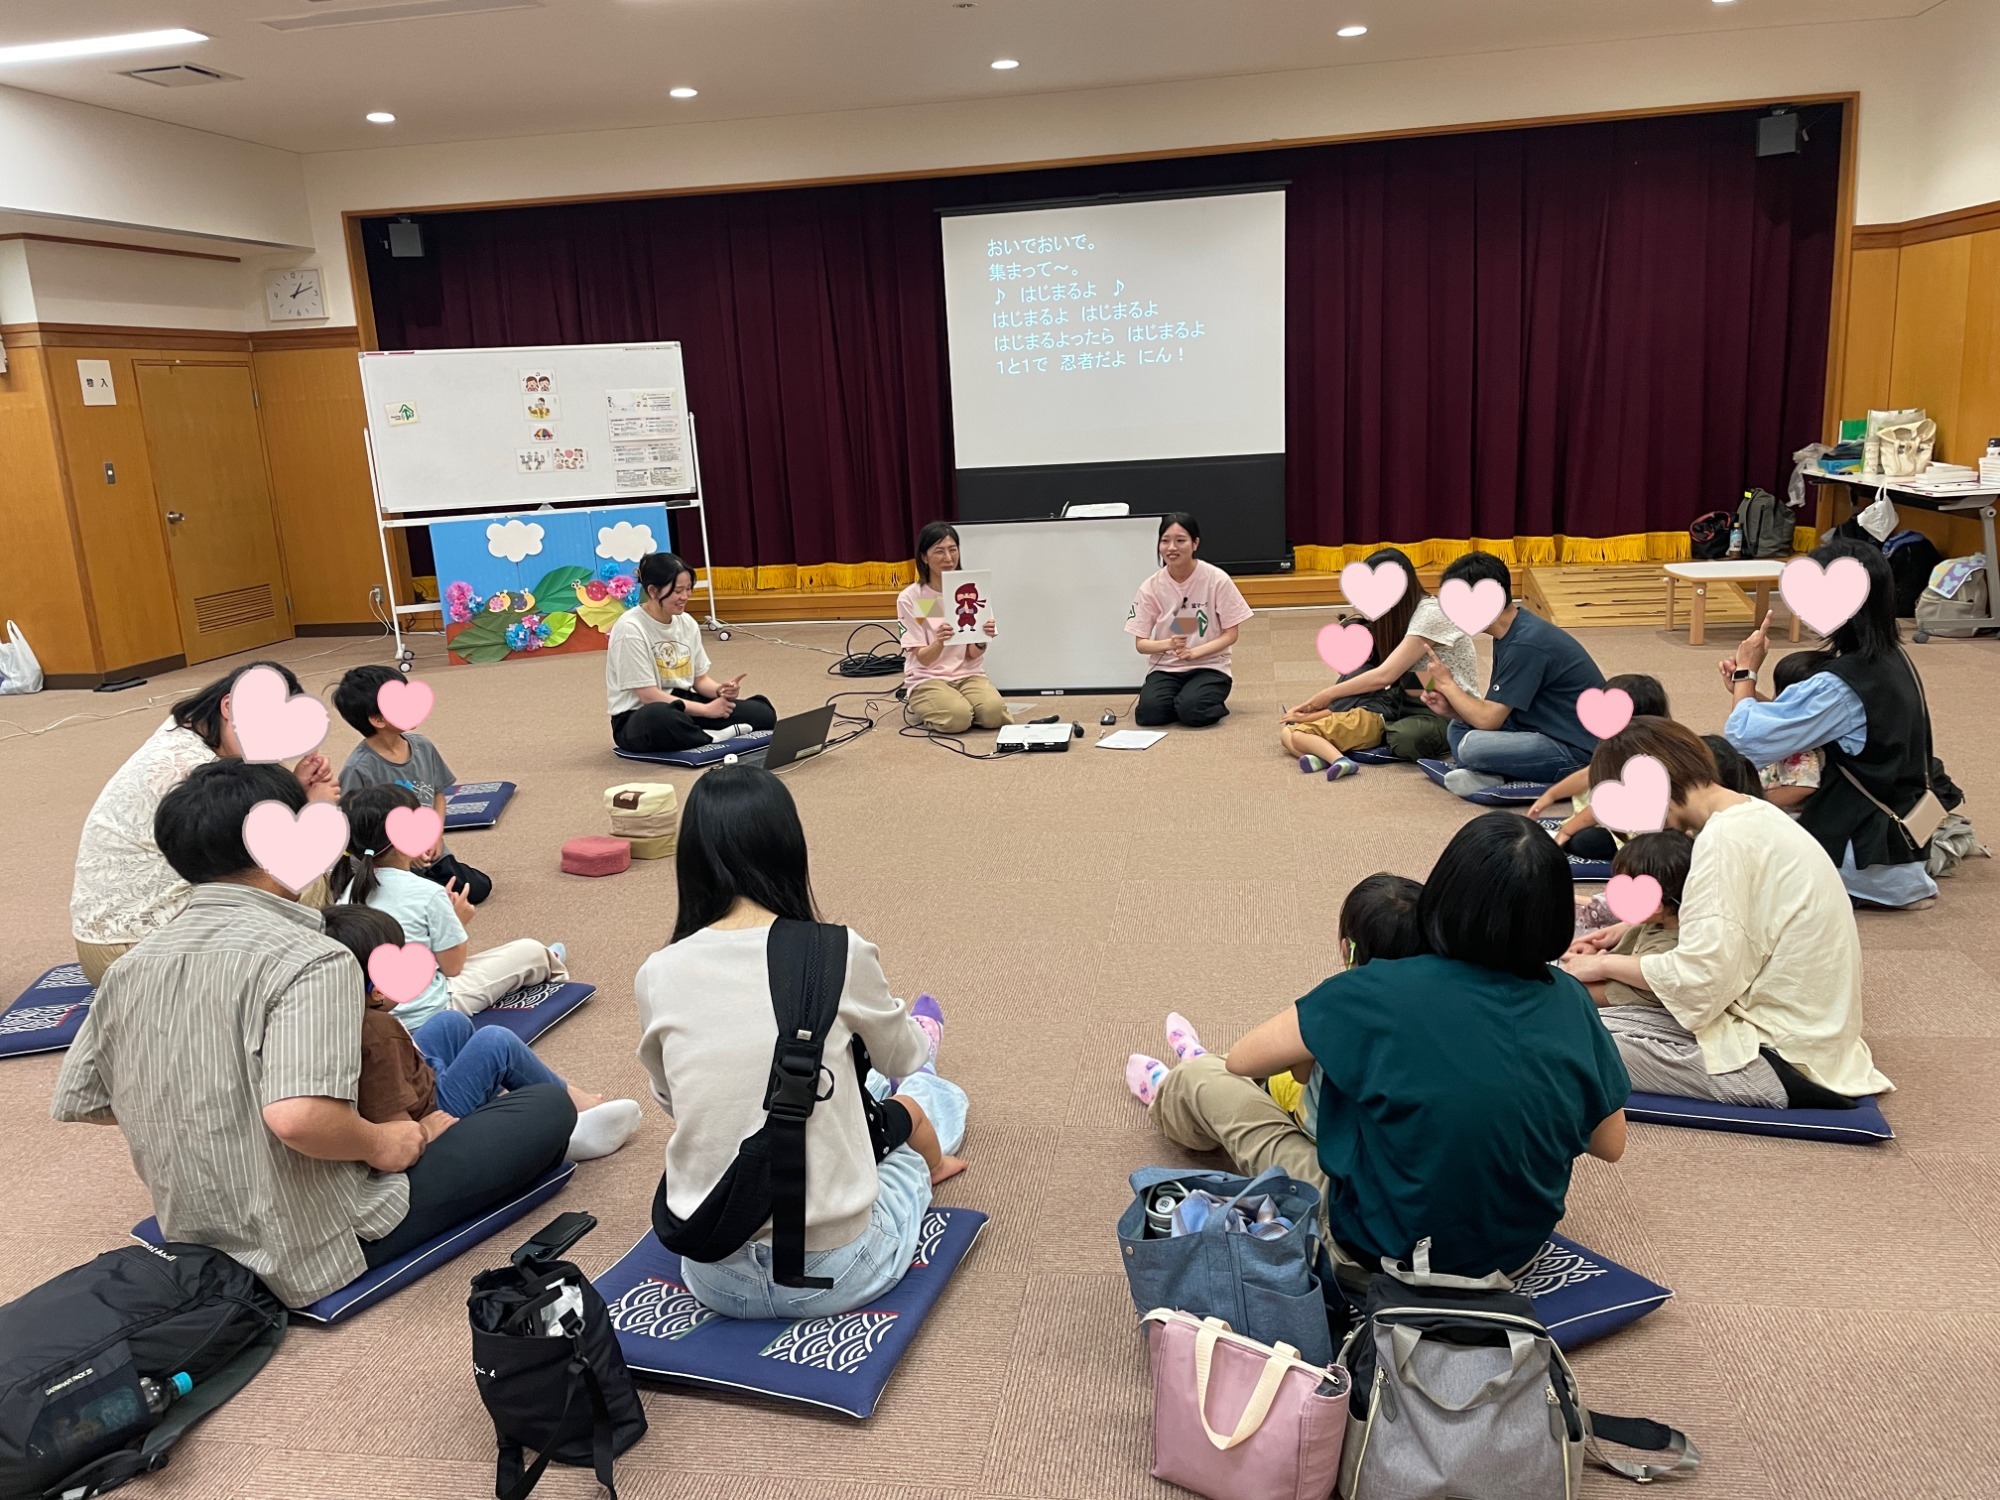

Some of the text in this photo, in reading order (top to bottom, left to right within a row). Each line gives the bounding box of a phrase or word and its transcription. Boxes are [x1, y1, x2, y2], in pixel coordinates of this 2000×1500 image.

[987, 234, 1095, 257] おいでおいで。
[1020, 281, 1097, 303] はじまるよ
[992, 300, 1158, 329] はじまるよ はじまるよ
[994, 320, 1205, 353] はじまるよったら はじまるよ
[996, 356, 1048, 375] 1と1で
[1060, 351, 1126, 372] 忍者だよ
